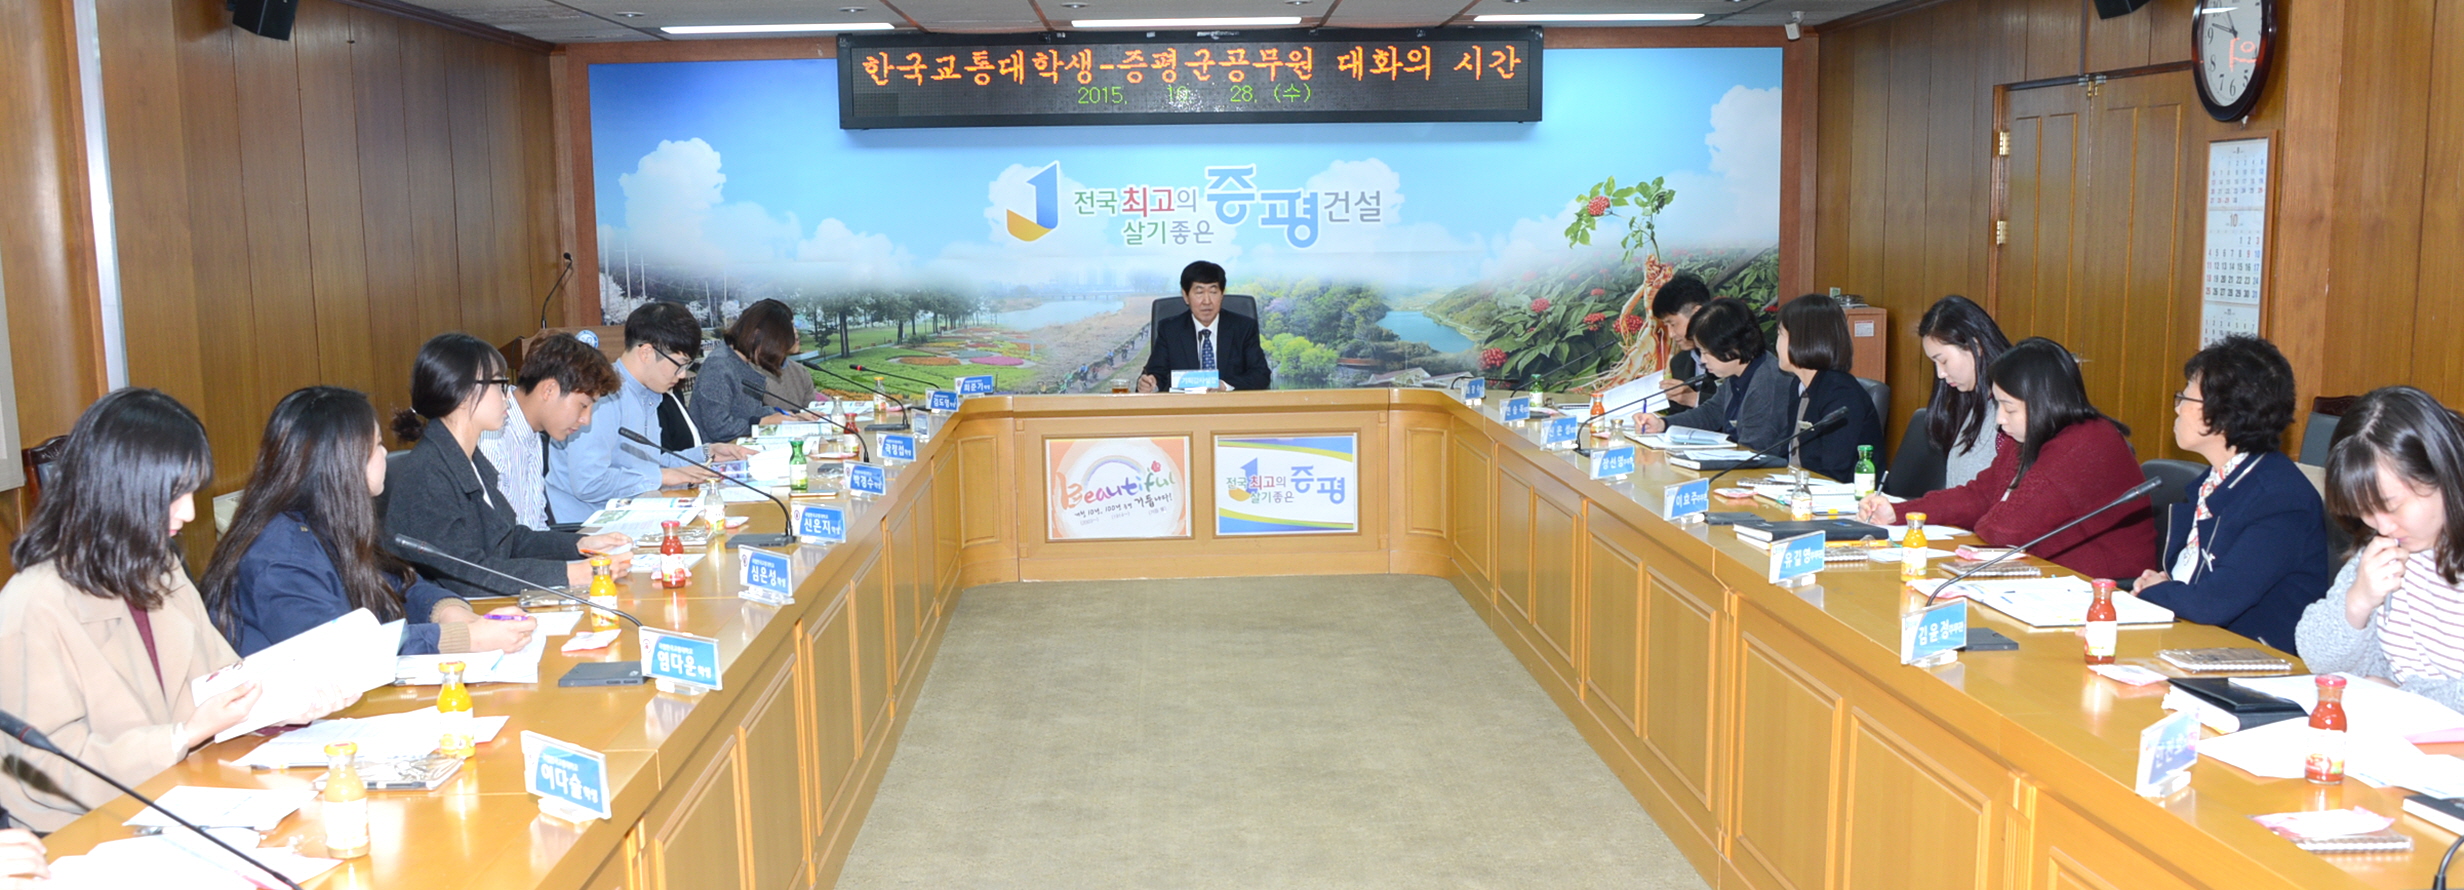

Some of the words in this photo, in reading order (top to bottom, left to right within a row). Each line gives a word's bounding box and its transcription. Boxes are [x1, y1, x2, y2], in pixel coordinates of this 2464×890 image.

[2207, 27, 2214, 44] 9
[1337, 45, 1430, 80] 대화의
[1454, 44, 1521, 79] 시간
[1273, 83, 1311, 103] (수)
[2229, 78, 2236, 96] 6
[803, 518, 831, 535] 신은지
[751, 565, 777, 587] 심은성
[657, 650, 697, 677] 염다운
